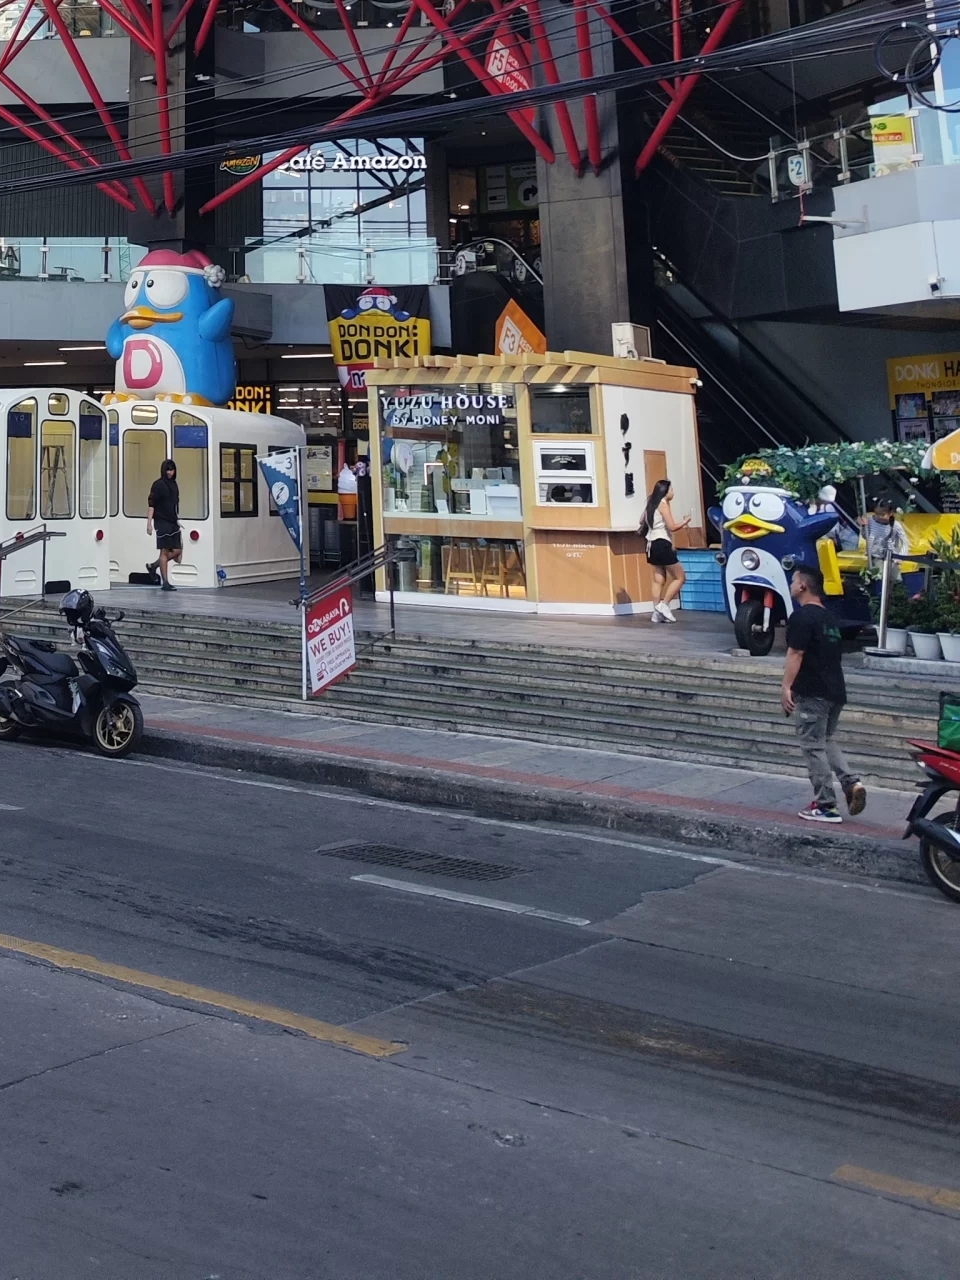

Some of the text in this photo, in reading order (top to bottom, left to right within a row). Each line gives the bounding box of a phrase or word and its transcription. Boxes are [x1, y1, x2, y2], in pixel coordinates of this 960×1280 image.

[334, 152, 427, 170] Amazon
[795, 160, 802, 175] 2
[341, 339, 419, 361] DONKI
[122, 338, 164, 390] D
[895, 361, 940, 381] DONKI
[381, 395, 433, 410] YUZU
[392, 415, 499, 426] by HONEY MONI
[285, 457, 293, 470] 3
[310, 638, 327, 658] WE
[328, 621, 351, 646] BUY!
